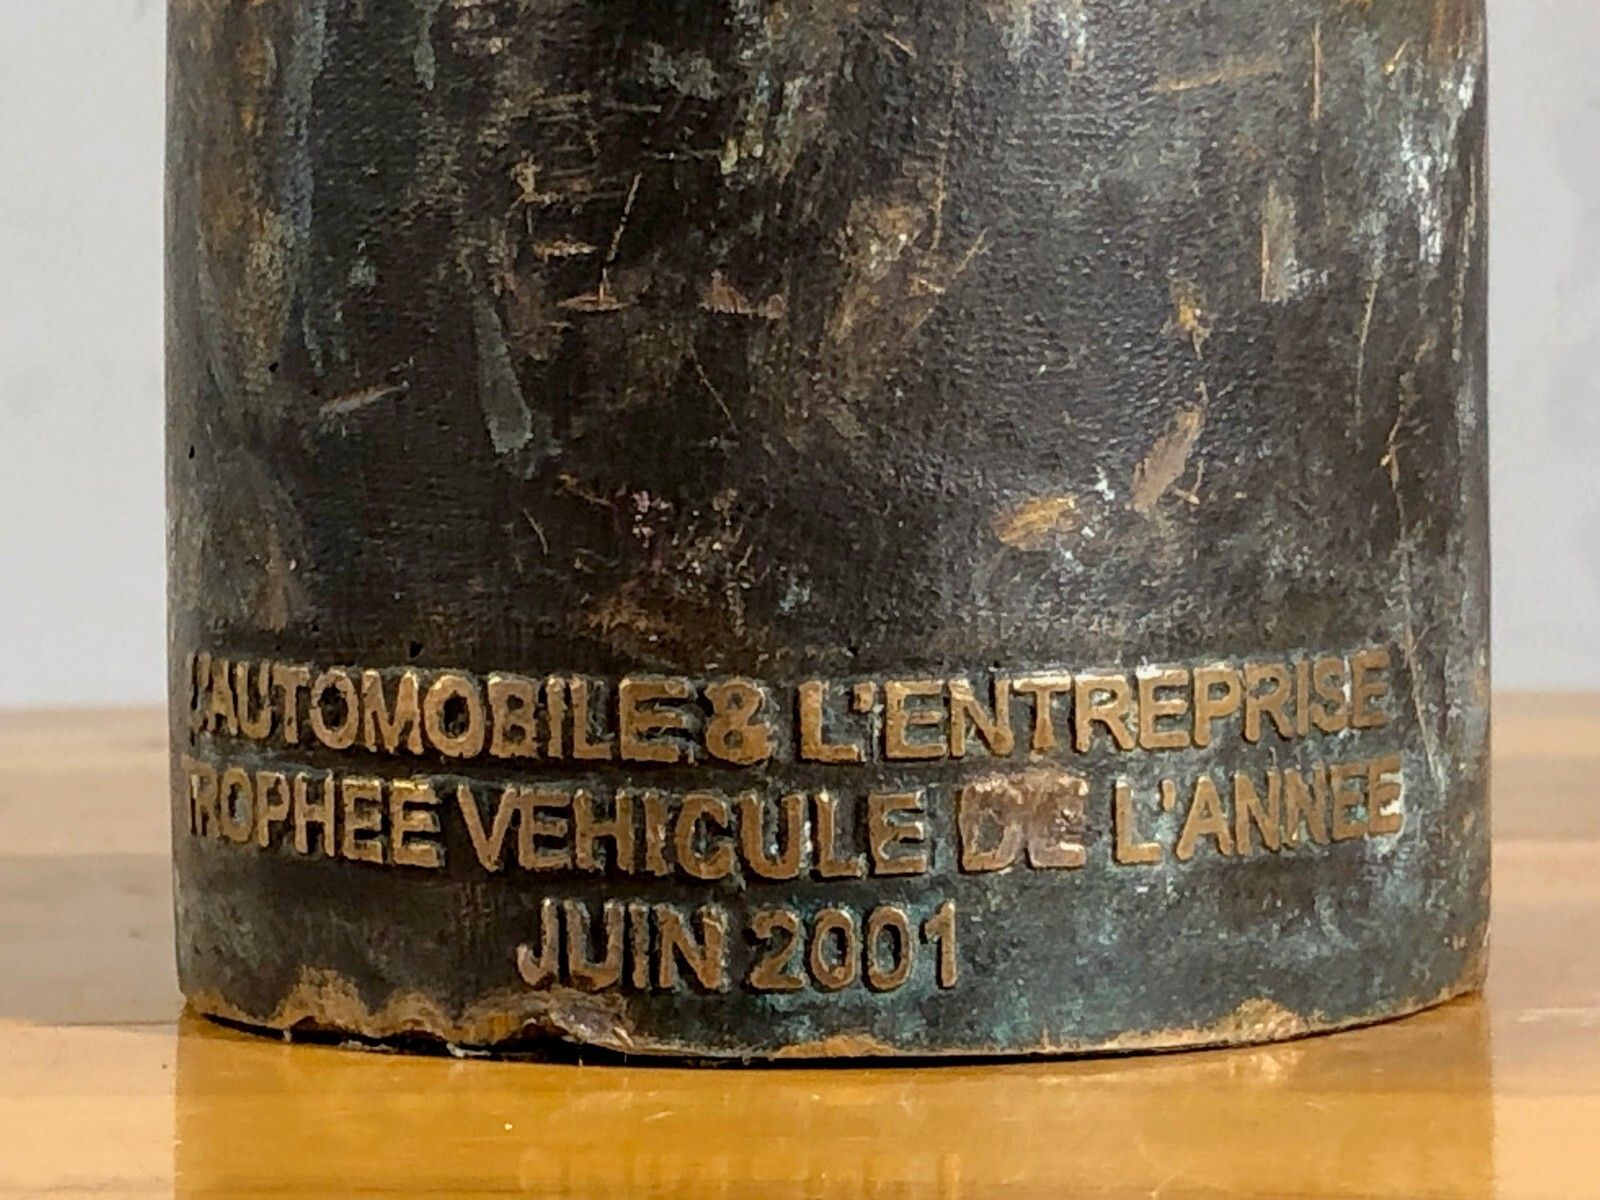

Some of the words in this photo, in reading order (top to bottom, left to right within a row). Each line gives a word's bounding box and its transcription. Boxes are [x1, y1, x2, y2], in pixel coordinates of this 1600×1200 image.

[704, 679, 776, 765] &
[799, 648, 1391, 764] L'ENTREPRISE
[456, 783, 930, 880] VEHICULE
[958, 770, 1089, 872] DE
[1113, 753, 1405, 866] L'ANNEE
[516, 898, 728, 992] JUIN
[747, 900, 957, 992] 2001
